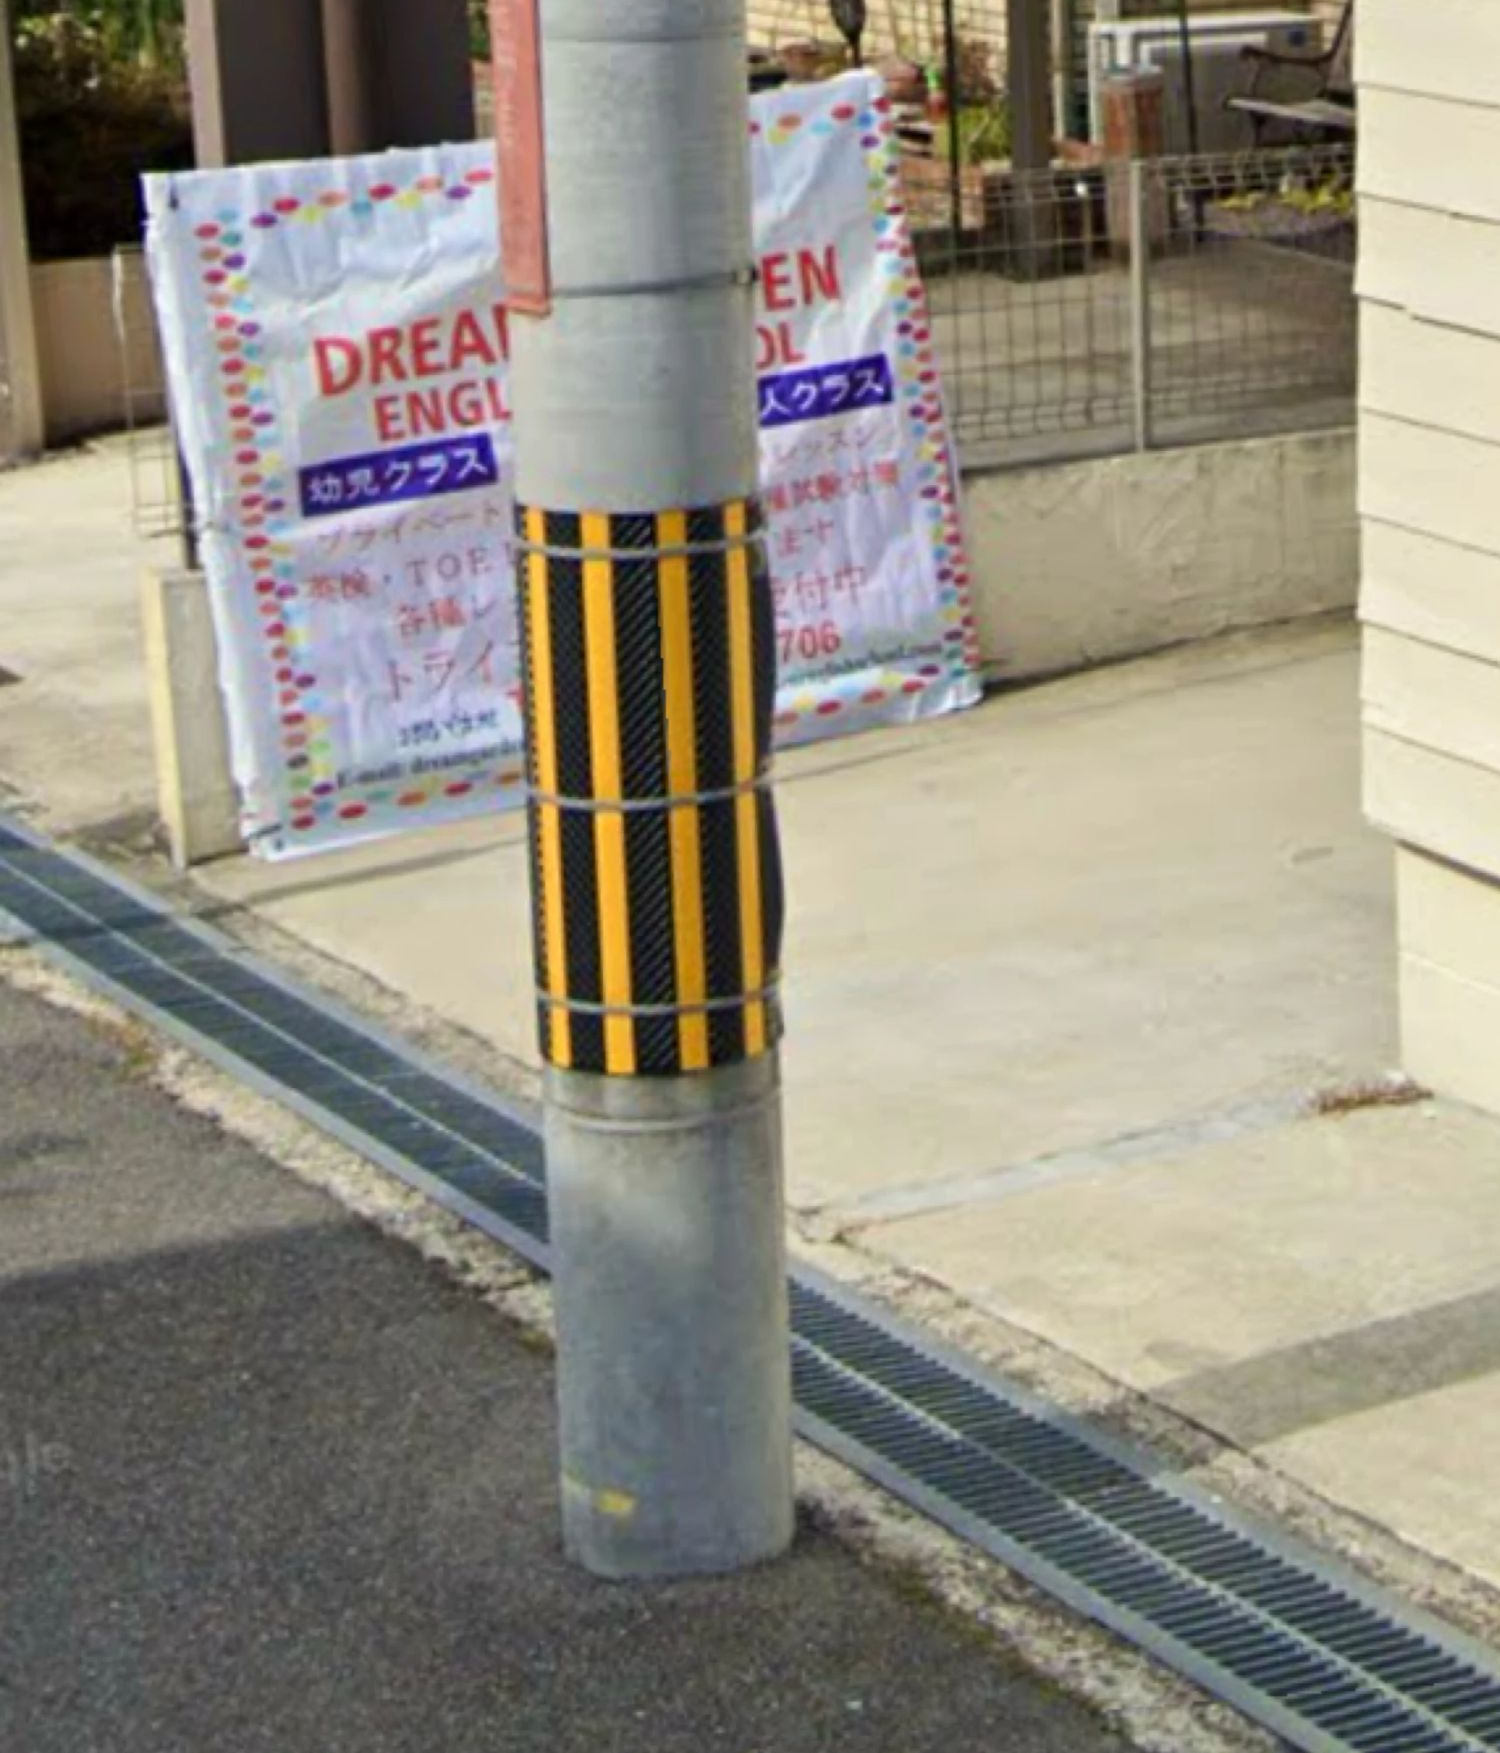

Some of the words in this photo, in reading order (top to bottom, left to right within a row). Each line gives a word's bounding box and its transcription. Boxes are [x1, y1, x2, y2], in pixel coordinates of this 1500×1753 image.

[307, 448, 489, 505] 幼児クラス
